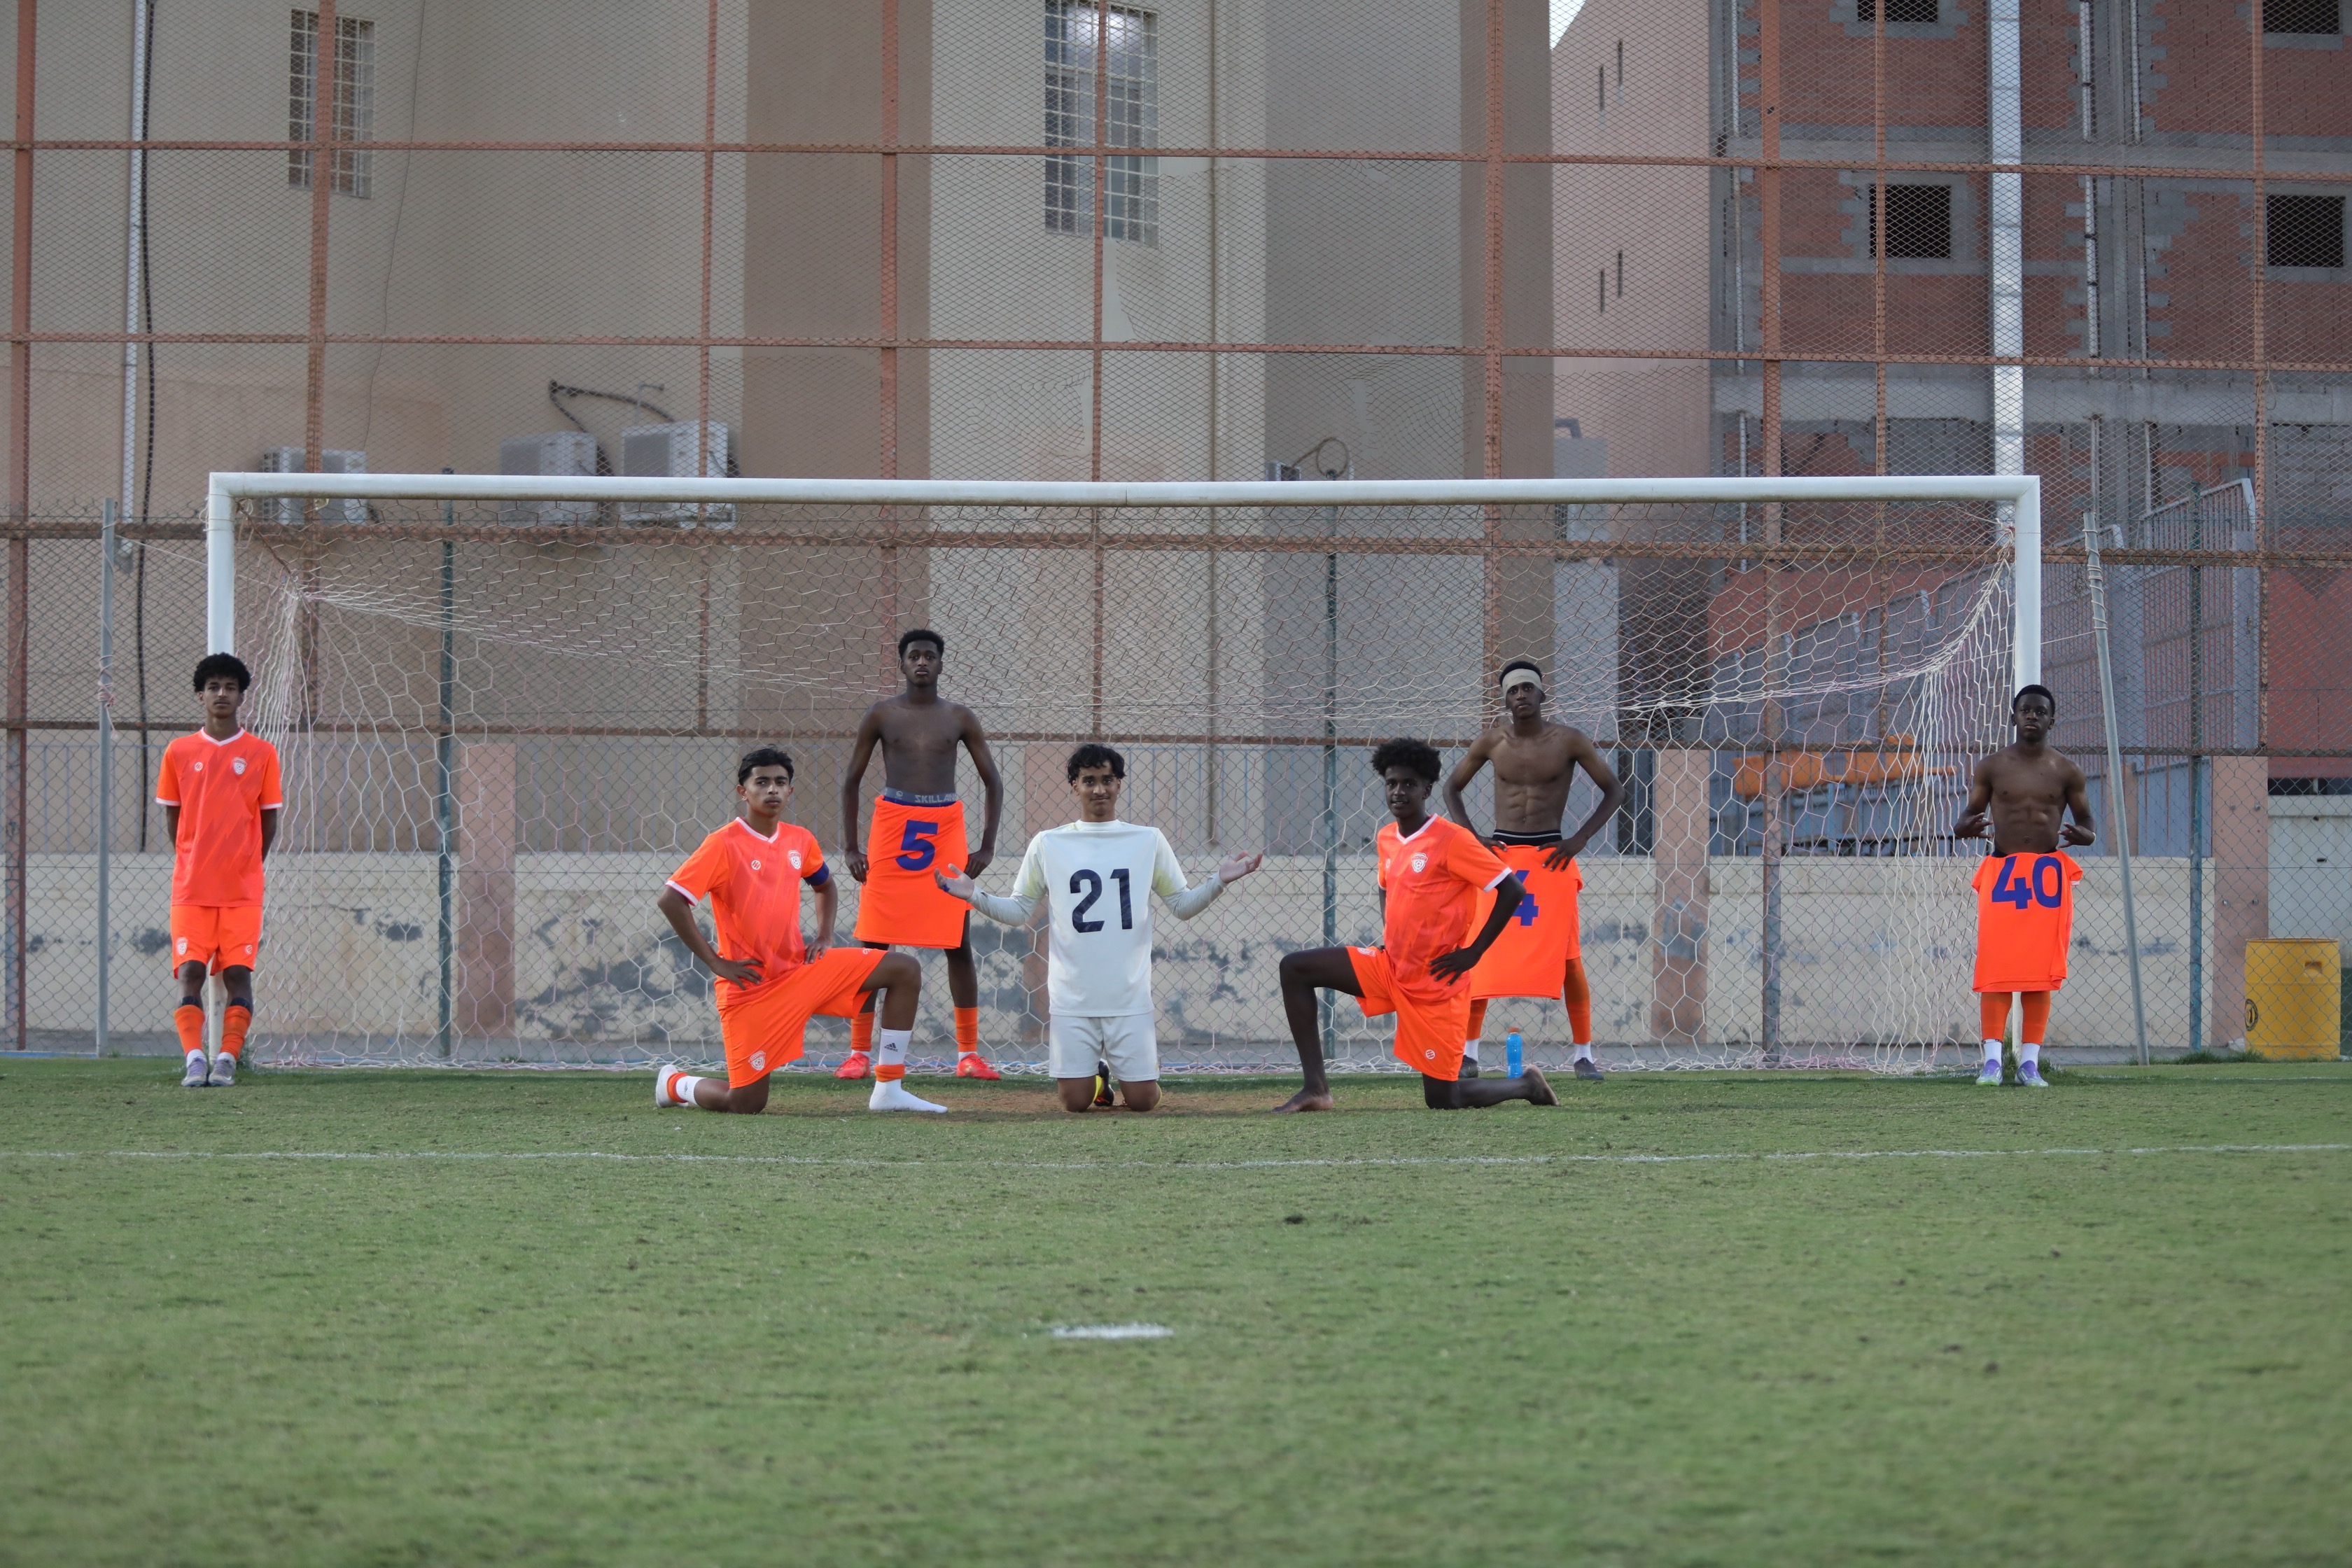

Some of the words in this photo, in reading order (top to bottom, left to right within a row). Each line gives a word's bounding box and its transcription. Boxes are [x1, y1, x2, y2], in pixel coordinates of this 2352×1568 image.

[895, 820, 938, 871] 5
[1070, 868, 1133, 933] 21
[1512, 869, 1539, 926] 4
[1991, 855, 2062, 909] 40
